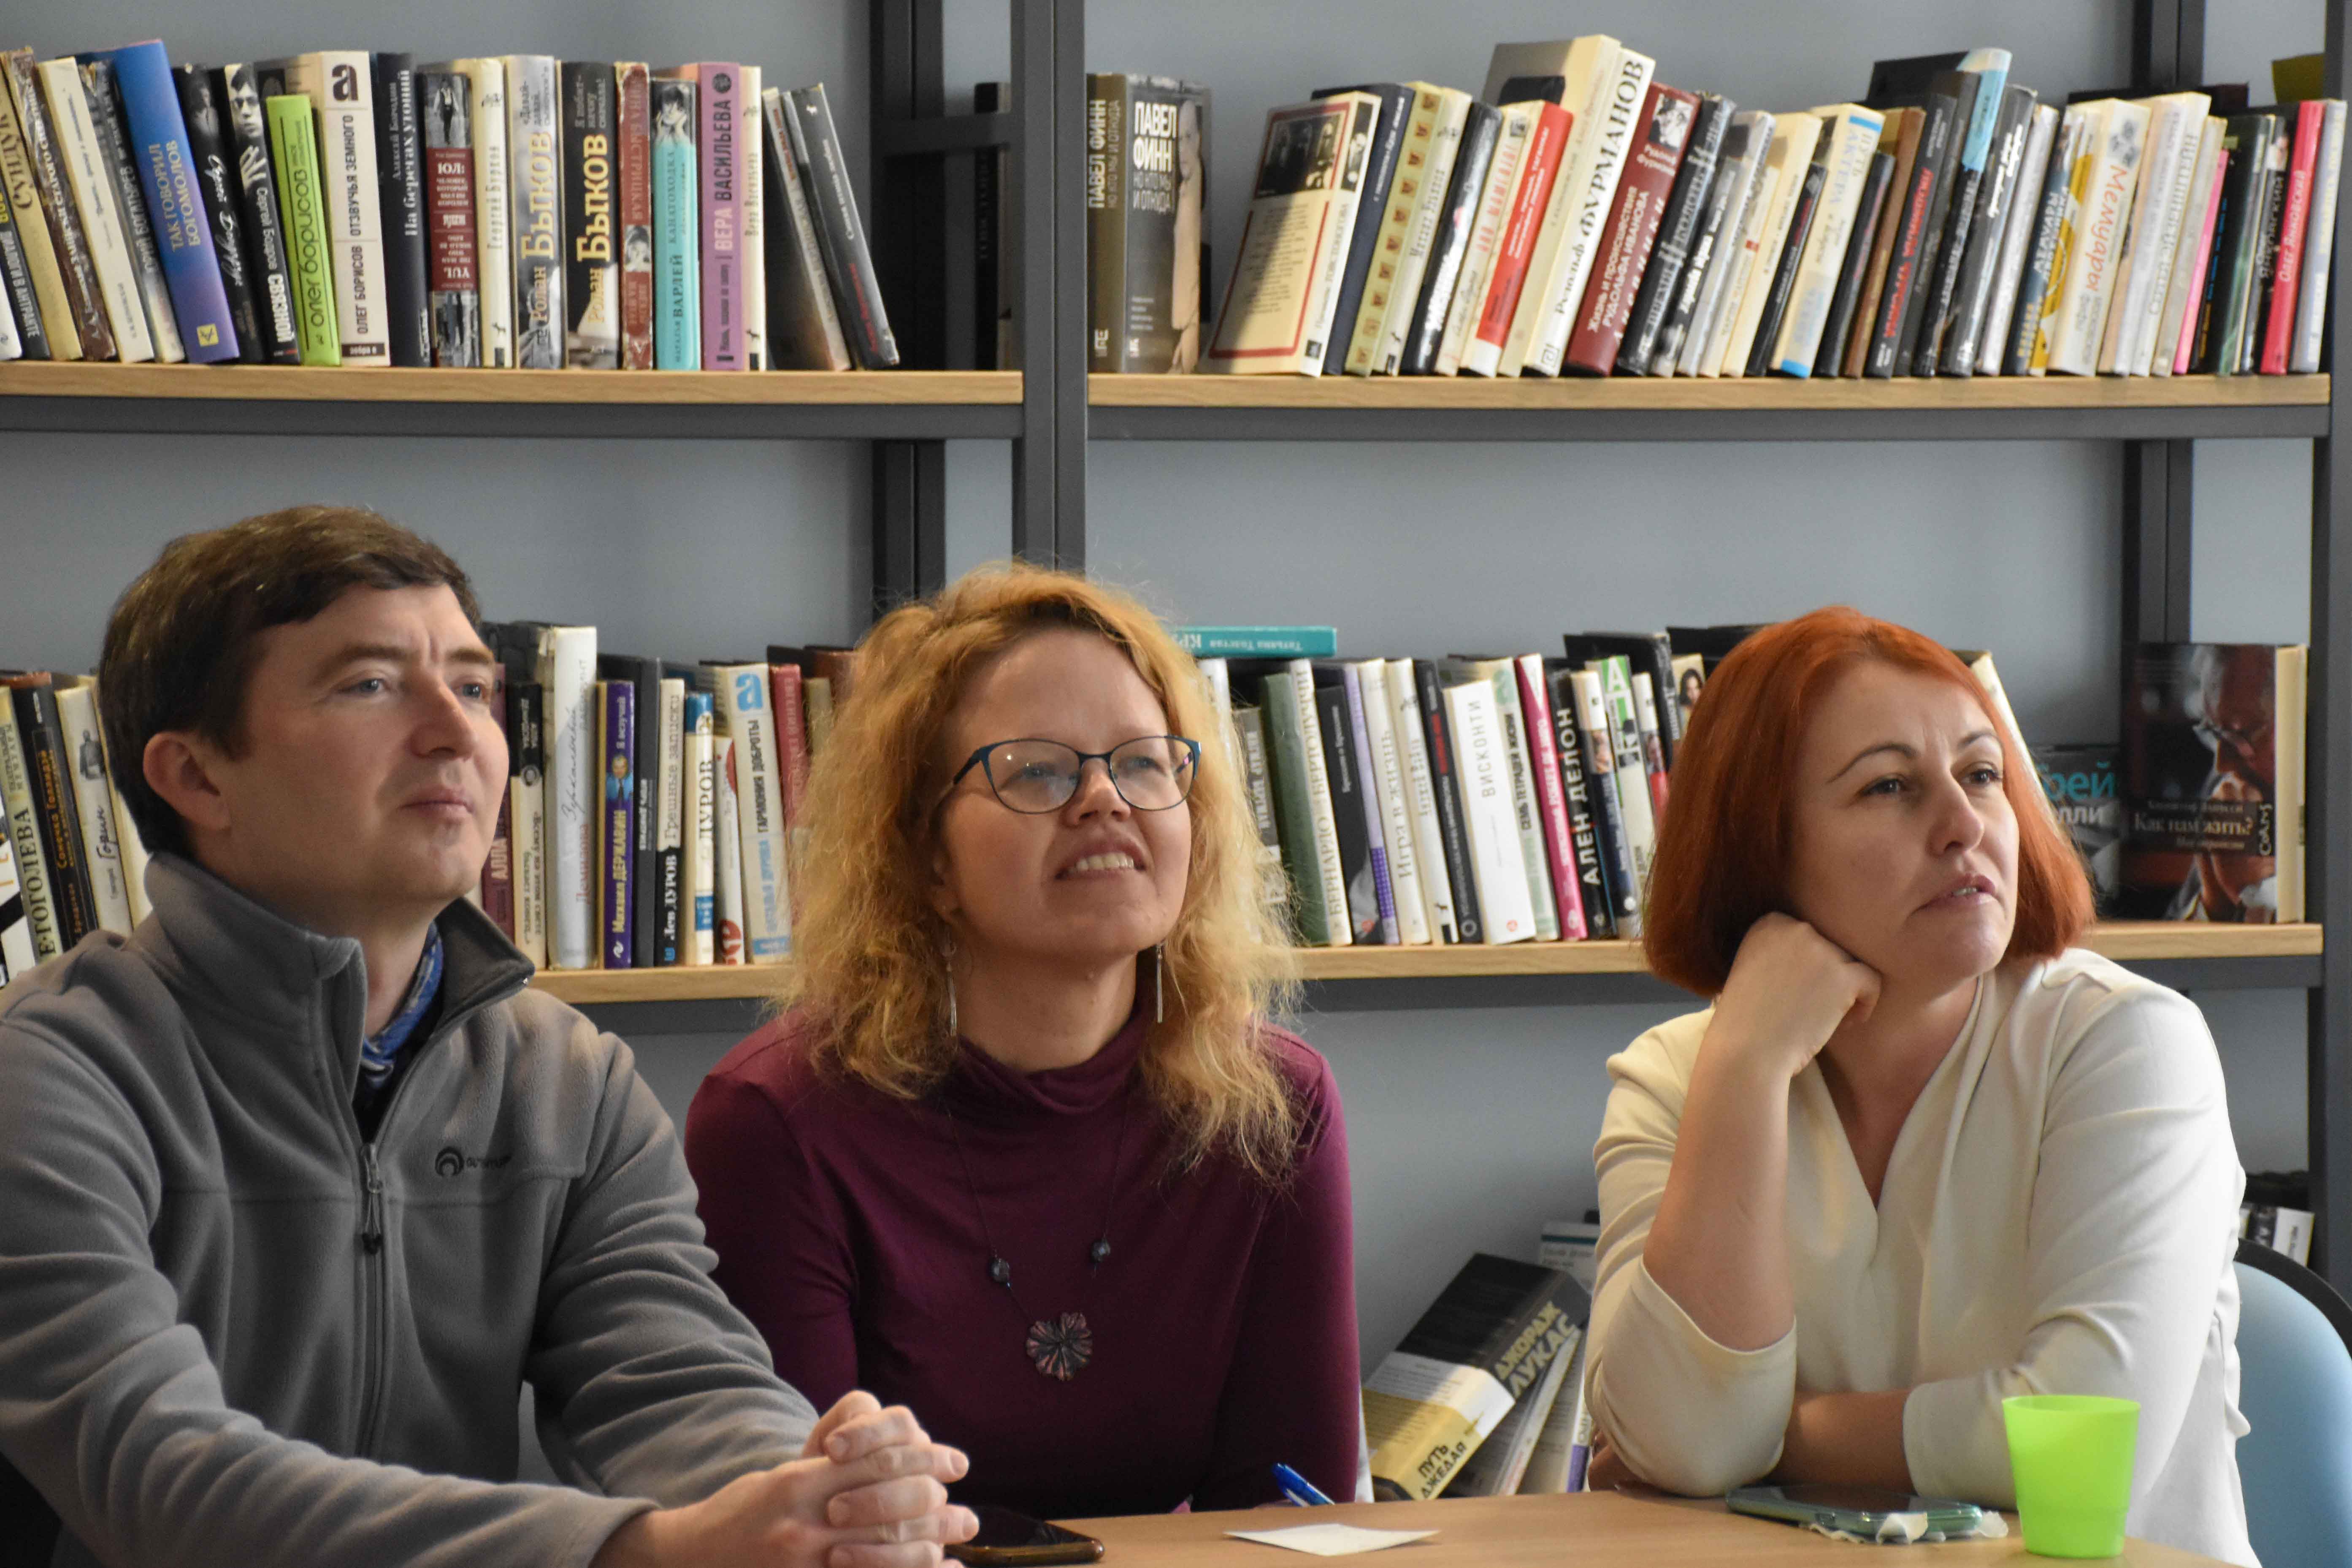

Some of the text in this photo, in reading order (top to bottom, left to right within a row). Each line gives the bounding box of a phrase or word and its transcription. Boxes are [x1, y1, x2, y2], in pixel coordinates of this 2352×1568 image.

[387, 82, 402, 179] Алексей Бородин
[1090, 100, 1106, 208] ПАВЕЛ ФИНН
[1133, 136, 1173, 172] ФИНН
[1134, 101, 1177, 138] ПАВЕЛ
[149, 144, 187, 252] ТАК ГОВОРИЛ
[167, 141, 200, 245] БОГОМОЛОВ
[396, 137, 420, 209] берегах
[630, 124, 643, 220] БЫСТРИЦКАЯ
[667, 152, 677, 244] КАНАТОХОДКА
[713, 100, 733, 251] ВЕРА ВАСИЛЬЕВА
[1554, 243, 1585, 314] Рудольф
[1581, 61, 1642, 240] ФУРМАНОВ
[257, 187, 295, 341] Сергей Бодров СВЯЗНОЙ
[286, 170, 317, 274] борисов
[342, 115, 368, 334] ОЛЕГ БОРИСОВ ОТЗВУЧЬЯ ЗЕМНОГО
[405, 211, 420, 236] На
[484, 197, 500, 250] Георгий
[514, 130, 558, 322] Ролан Быков
[570, 132, 614, 324] Ролан Быков
[1588, 187, 1639, 331] Жизнь и происшествия
[1603, 192, 1648, 327] РУДОЛЬФА ИВАНОВА
[2034, 191, 2060, 274] МЕМУАРЫ
[2079, 162, 2130, 293] Мемуары
[16, 287, 40, 336] АНТРАКТЕ
[444, 267, 470, 279] YUL
[670, 255, 683, 317] ВАРЛЕЙ
[749, 720, 764, 772] ДОБРОТЫ
[1299, 669, 1345, 915] БЕРНАРДО БЕРТОЛУЧЧИ
[1469, 701, 1496, 798] ВИСКОНТИ
[1505, 714, 1530, 829] СЕМЬ ТЕТРАДЕЙ ЖИЗНИ
[1557, 709, 1586, 801] ДЕЛОН
[94, 804, 121, 860] Горин
[663, 694, 682, 940] Лев ДУРОВ Грешные записки
[697, 759, 715, 840] ДУРОВ
[754, 776, 767, 832] ГАРМОНИЯ
[1381, 729, 1416, 880] Игра в жизнь
[2135, 811, 2164, 831] Как
[489, 838, 509, 880] АЛЛА
[575, 823, 590, 905] Демидова
[613, 810, 627, 932] Михаил ДЕРЖАВИН
[1573, 813, 1599, 884] АЛЕН
[1489, 1300, 1564, 1381] ДЖОРДЖ
[1501, 1312, 1581, 1397] ЛУКАС
[1414, 1440, 1451, 1478] ПУТЬ
[1415, 1440, 1471, 1500] ДЖЕДАЯ
